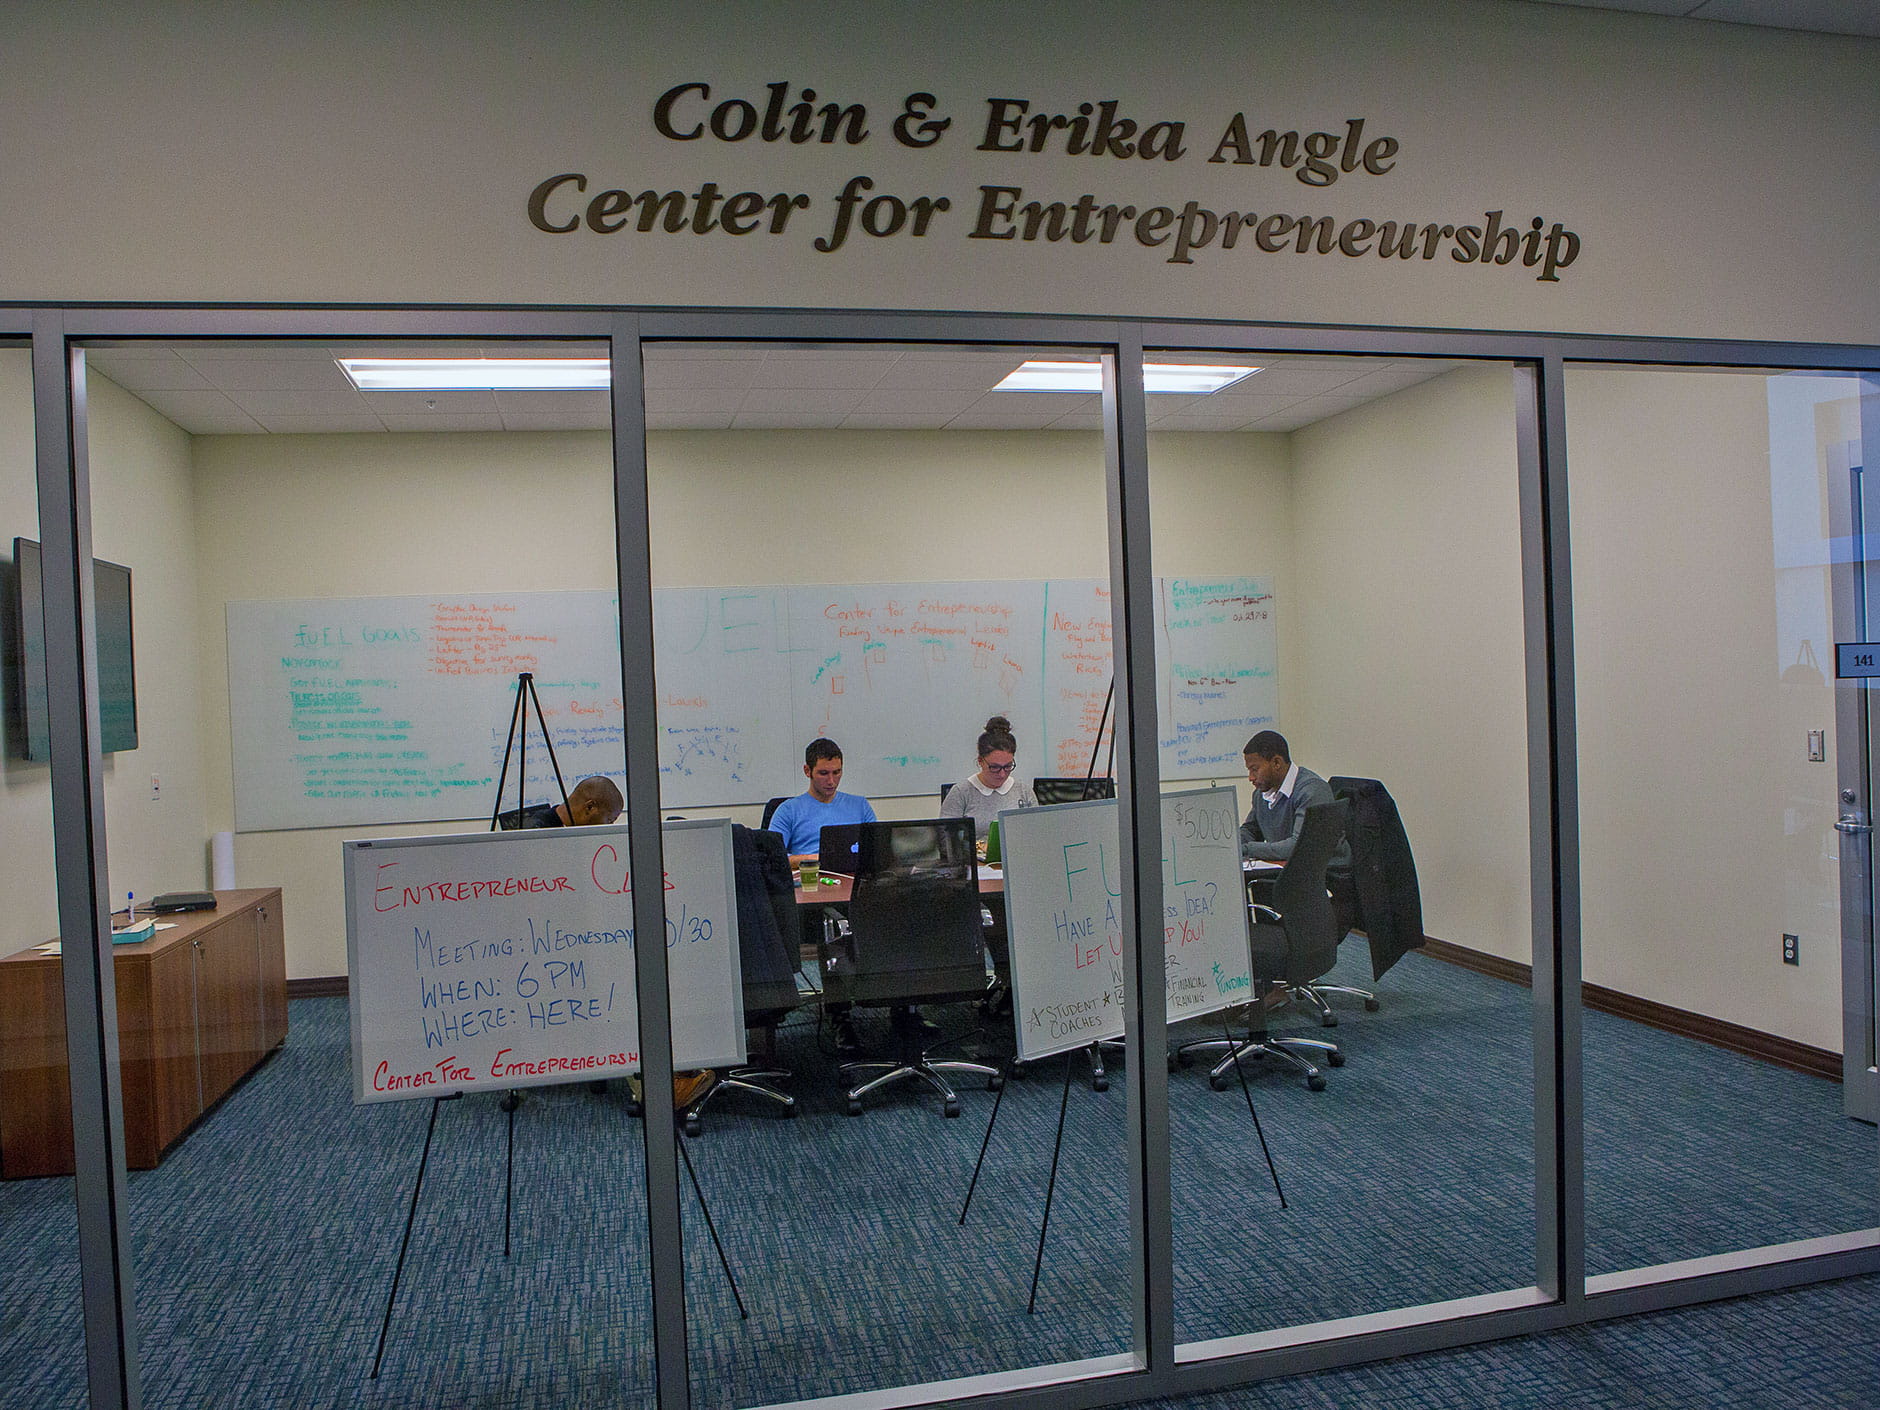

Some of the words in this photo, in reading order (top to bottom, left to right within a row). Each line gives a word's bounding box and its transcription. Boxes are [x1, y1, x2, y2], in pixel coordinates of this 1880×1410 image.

[654, 81, 869, 144] Colin
[893, 92, 951, 148] &
[977, 97, 1187, 161] Erika
[1208, 112, 1400, 187] Angle
[527, 173, 810, 234] Center
[814, 175, 951, 253] for
[968, 185, 1581, 282] Entrepreneurship
[1854, 654, 1875, 666] 141
[1175, 802, 1233, 840] $5,000
[374, 861, 575, 912] ENTREPRENEUR
[1184, 882, 1217, 918] IDEA?
[414, 926, 525, 971] MEETING:
[527, 917, 634, 956] WEDNESDAY
[1054, 910, 1094, 942] HAVE
[1075, 942, 1103, 969] LET
[421, 976, 501, 1009] WHEN:
[516, 962, 540, 998] 6
[544, 960, 587, 991] PM
[1215, 970, 1249, 997] FUNDING
[422, 1008, 516, 1049] WHERE:
[528, 982, 616, 1031] HERE!
[1046, 997, 1098, 1022] STUDENT
[1050, 1015, 1103, 1040] COACHES
[373, 1060, 437, 1091] CENTER
[435, 1055, 476, 1083] FOR
[490, 1048, 638, 1078] ENTREPRENEURSH
